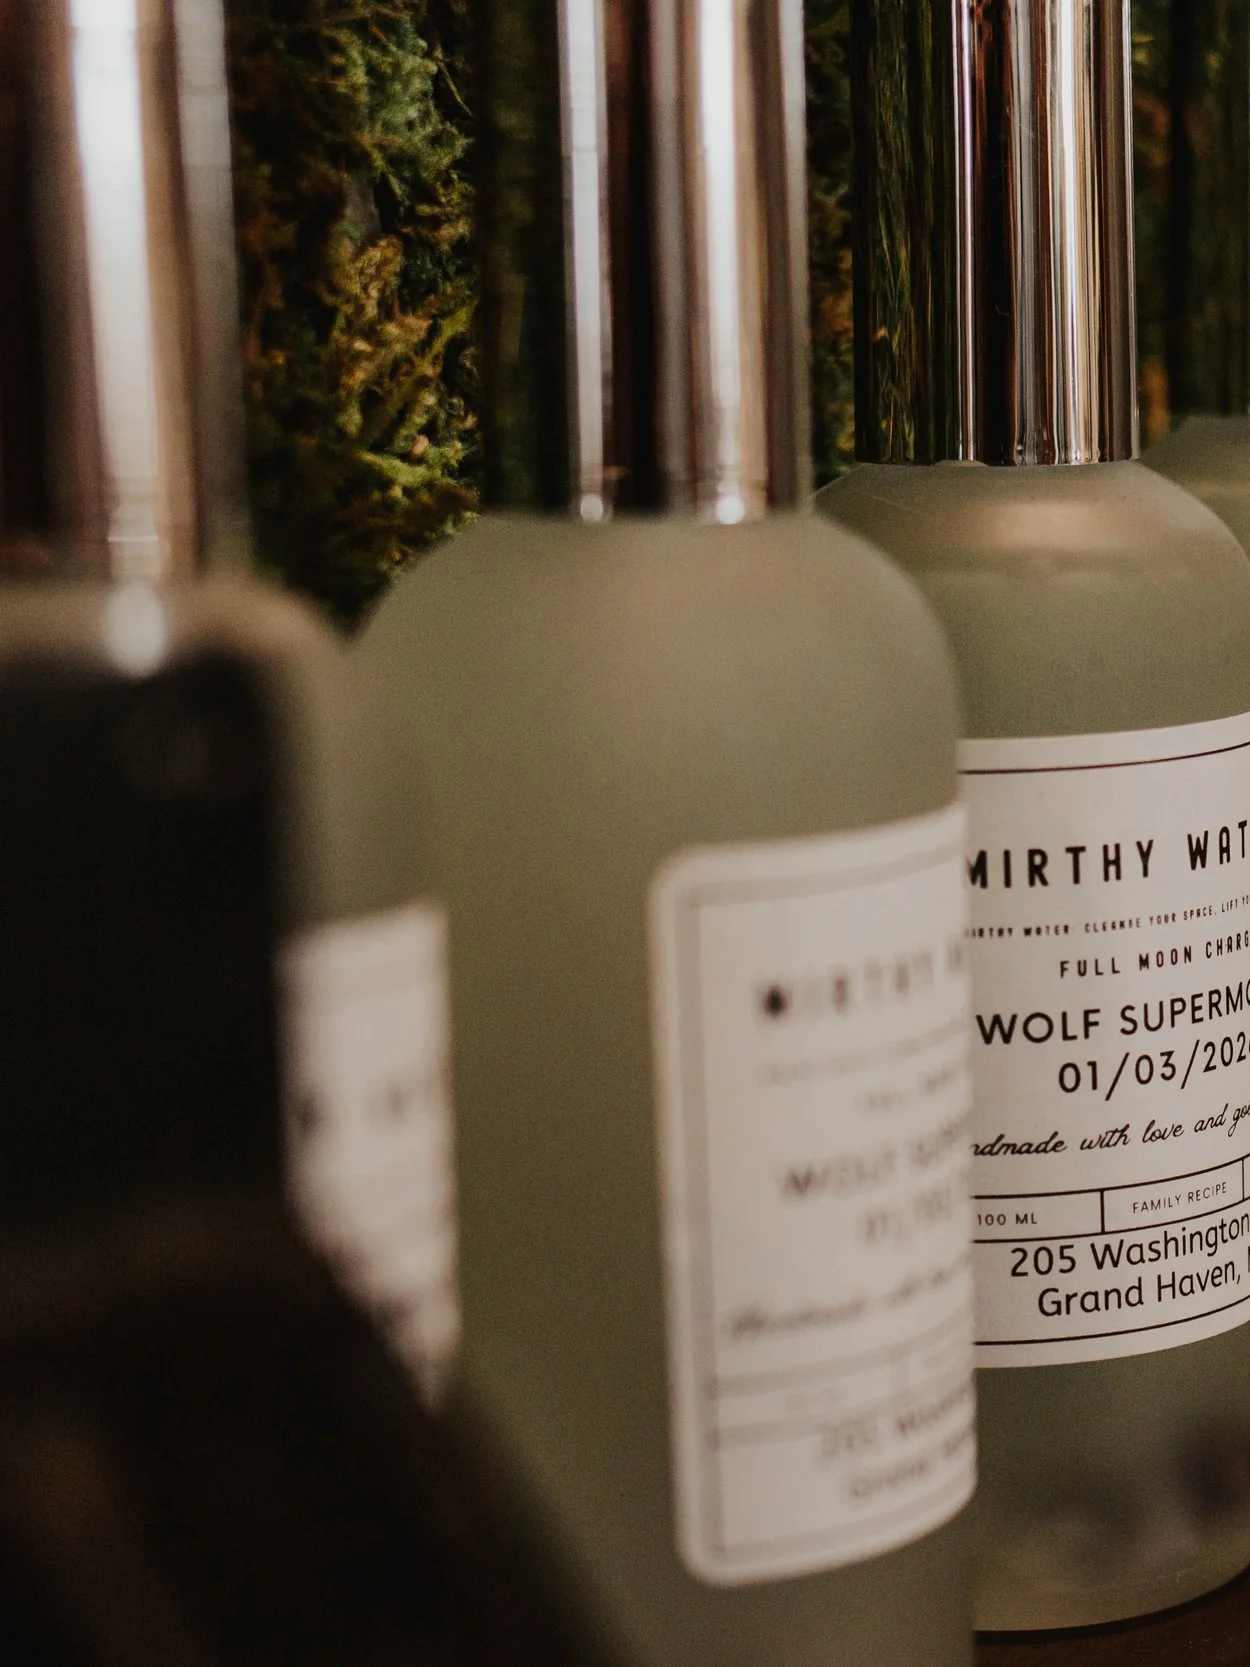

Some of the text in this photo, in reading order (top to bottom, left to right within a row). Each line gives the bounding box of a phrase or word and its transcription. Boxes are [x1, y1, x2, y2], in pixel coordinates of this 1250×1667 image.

[965, 839, 1154, 889] MIRTHY
[1084, 918, 1141, 933] CLEANSE
[1149, 912, 1176, 926] YOUR
[1221, 898, 1238, 913] LIFT
[1060, 957, 1121, 979] FULL
[1138, 945, 1192, 972] MOON
[975, 1008, 1101, 1045] WOLF
[1079, 1123, 1131, 1151] with
[1141, 1119, 1185, 1144] love
[1193, 1102, 1228, 1133] and
[1132, 1182, 1227, 1214] FAMILY RECIPE
[977, 1212, 1038, 1226] 100 ML
[1010, 1244, 1077, 1278] 205
[1090, 1213, 1250, 1270] Washington
[1037, 1276, 1144, 1318] Grand
[1156, 1260, 1241, 1303] Haven,
